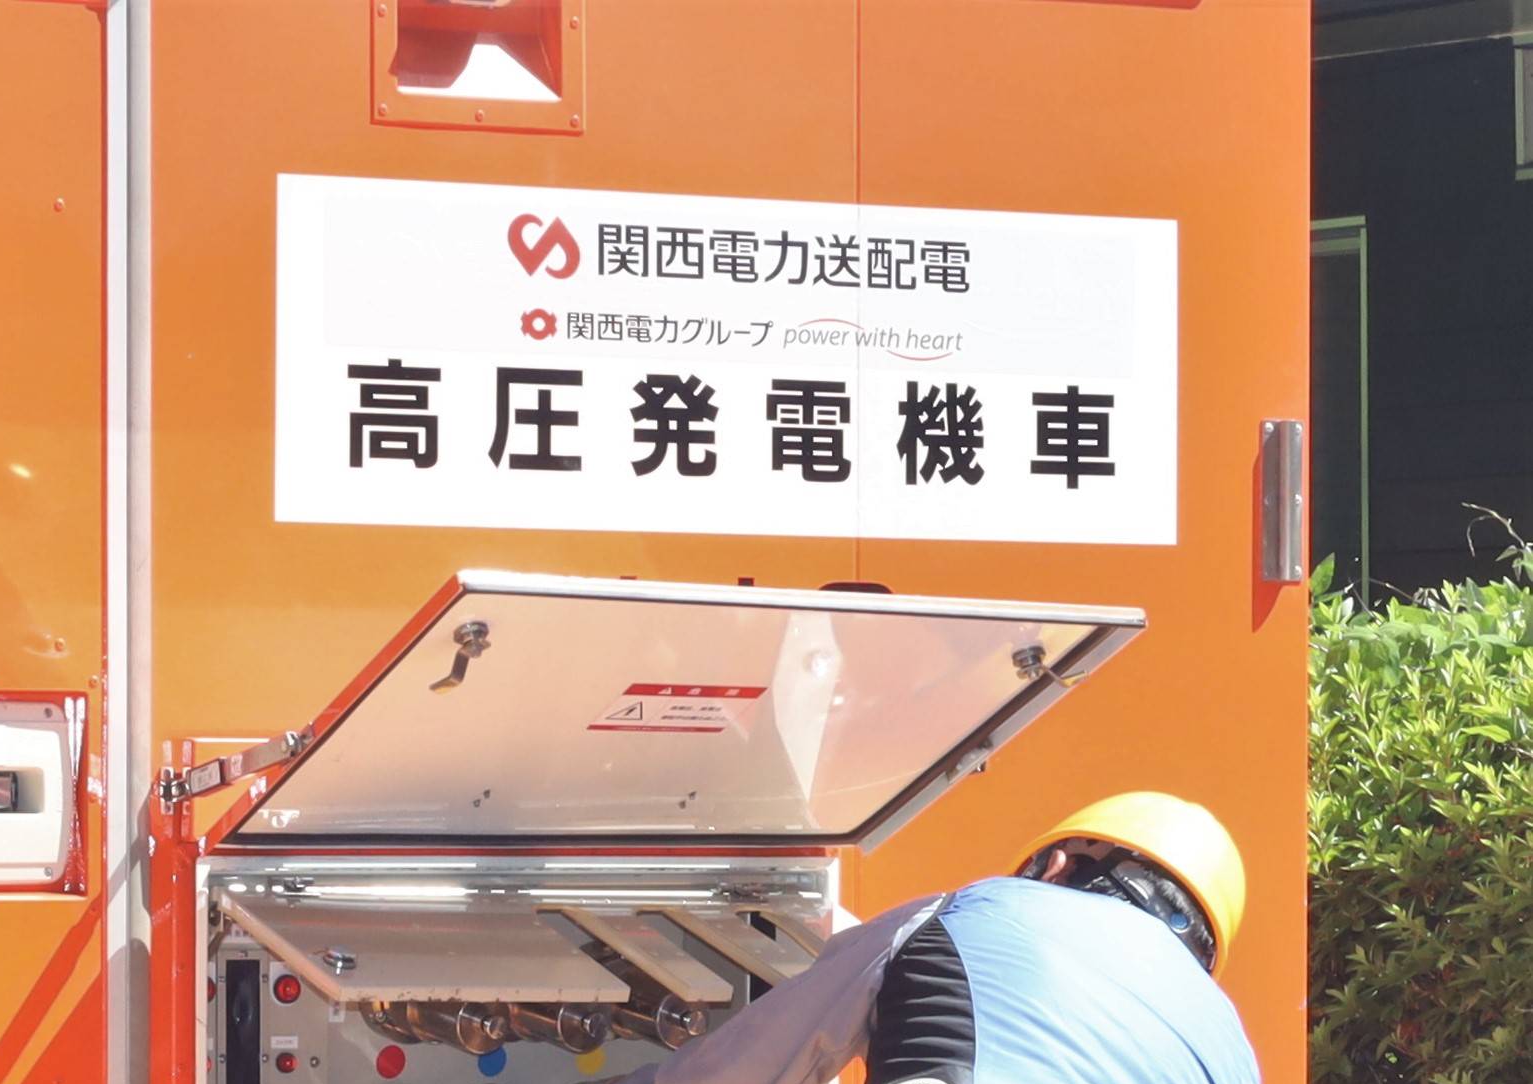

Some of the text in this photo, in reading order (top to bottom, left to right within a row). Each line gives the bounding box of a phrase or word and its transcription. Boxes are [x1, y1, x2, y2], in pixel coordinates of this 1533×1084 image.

[597, 222, 972, 295] 関西電力送配電
[567, 312, 774, 347] 関西電力グループ
[783, 327, 964, 352] power with heart
[346, 358, 1117, 490] 高圧発電機車
